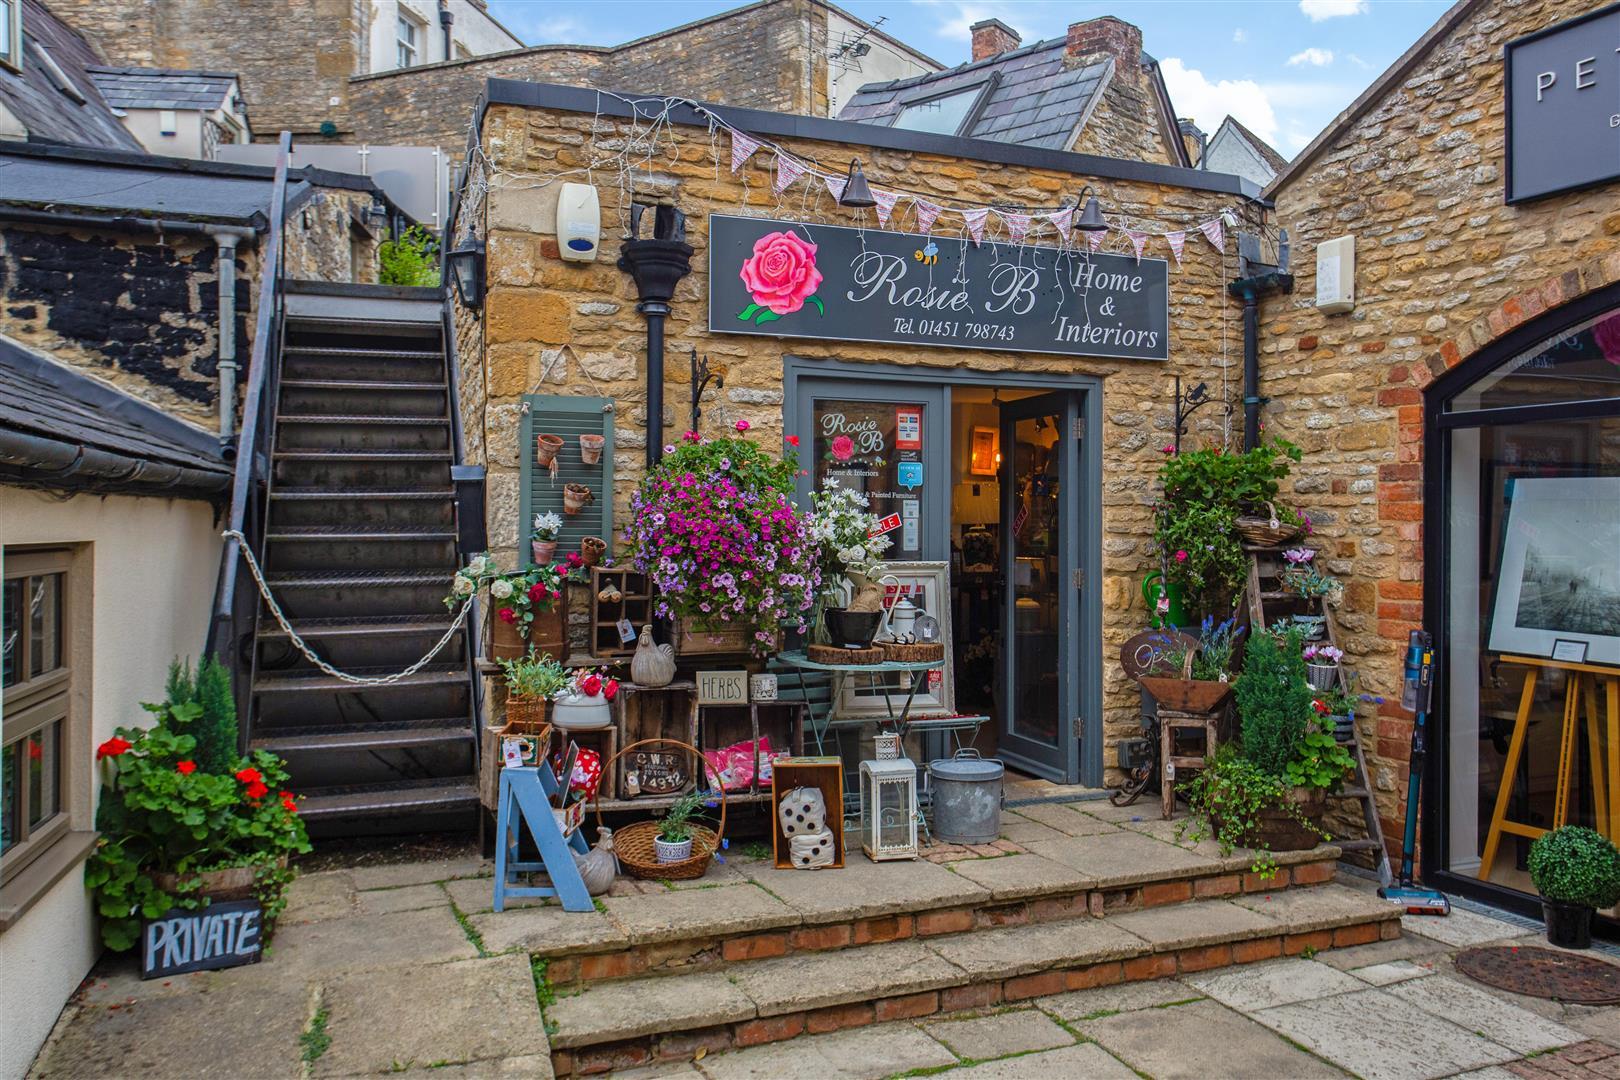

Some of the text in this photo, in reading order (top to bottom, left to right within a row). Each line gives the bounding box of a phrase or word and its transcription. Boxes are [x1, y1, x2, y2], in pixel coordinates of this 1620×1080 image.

[1536, 47, 1620, 102] PE
[847, 251, 1039, 315] Rosie B
[1073, 260, 1143, 294] Home
[1100, 297, 1116, 316] &
[893, 317, 1015, 341] Tel. 01451 798743
[1055, 316, 1158, 348] Interiors
[821, 413, 877, 436] Rosie
[858, 431, 884, 454] B
[854, 469, 879, 477] Interiors
[702, 677, 742, 699] HERBS
[146, 910, 261, 971] PRIVATE
